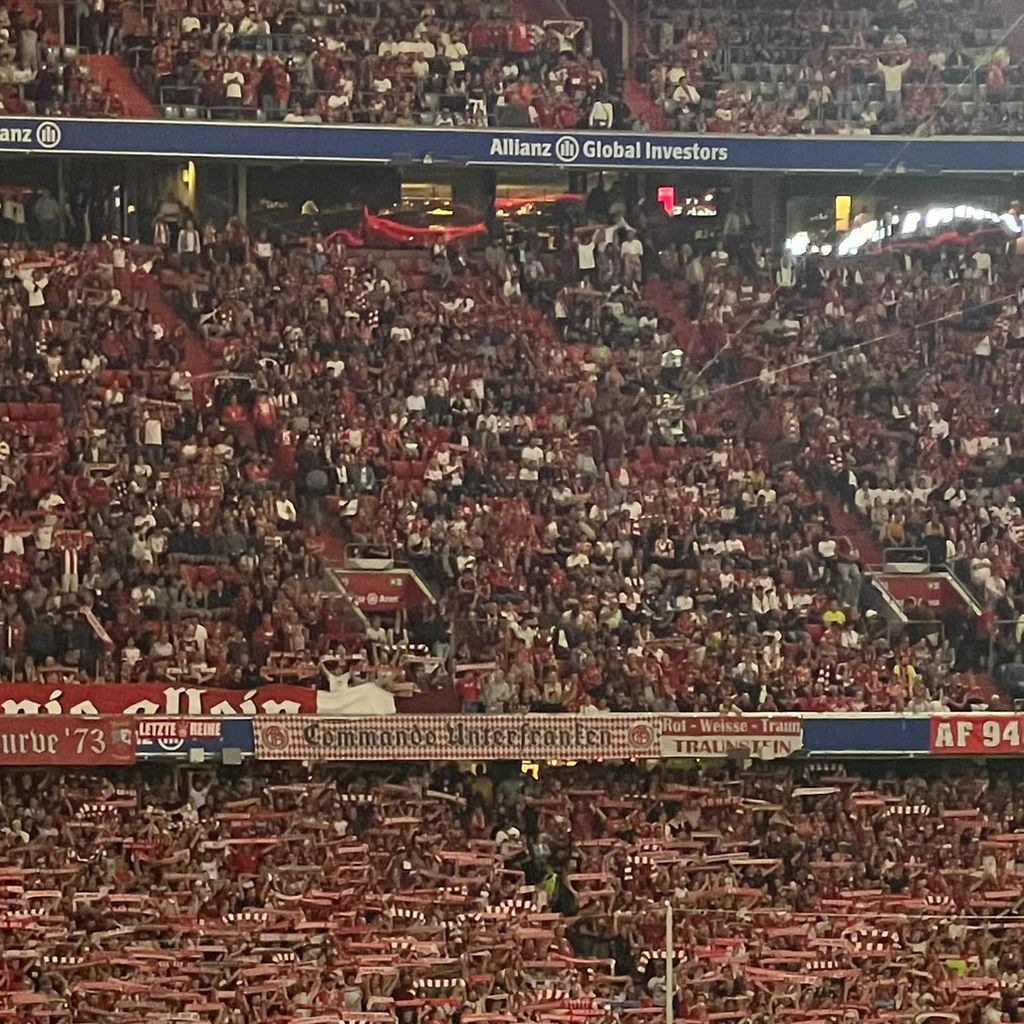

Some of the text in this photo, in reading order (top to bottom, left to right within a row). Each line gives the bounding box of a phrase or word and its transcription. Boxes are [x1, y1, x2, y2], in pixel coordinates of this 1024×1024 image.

[490, 138, 728, 161] Allianz Global Investors
[139, 721, 177, 736] LETZTE
[303, 721, 612, 753] Commando Unterfranken
[700, 719, 749, 733] Weisse
[762, 719, 801, 733] Traun
[935, 720, 1020, 748] AF 94
